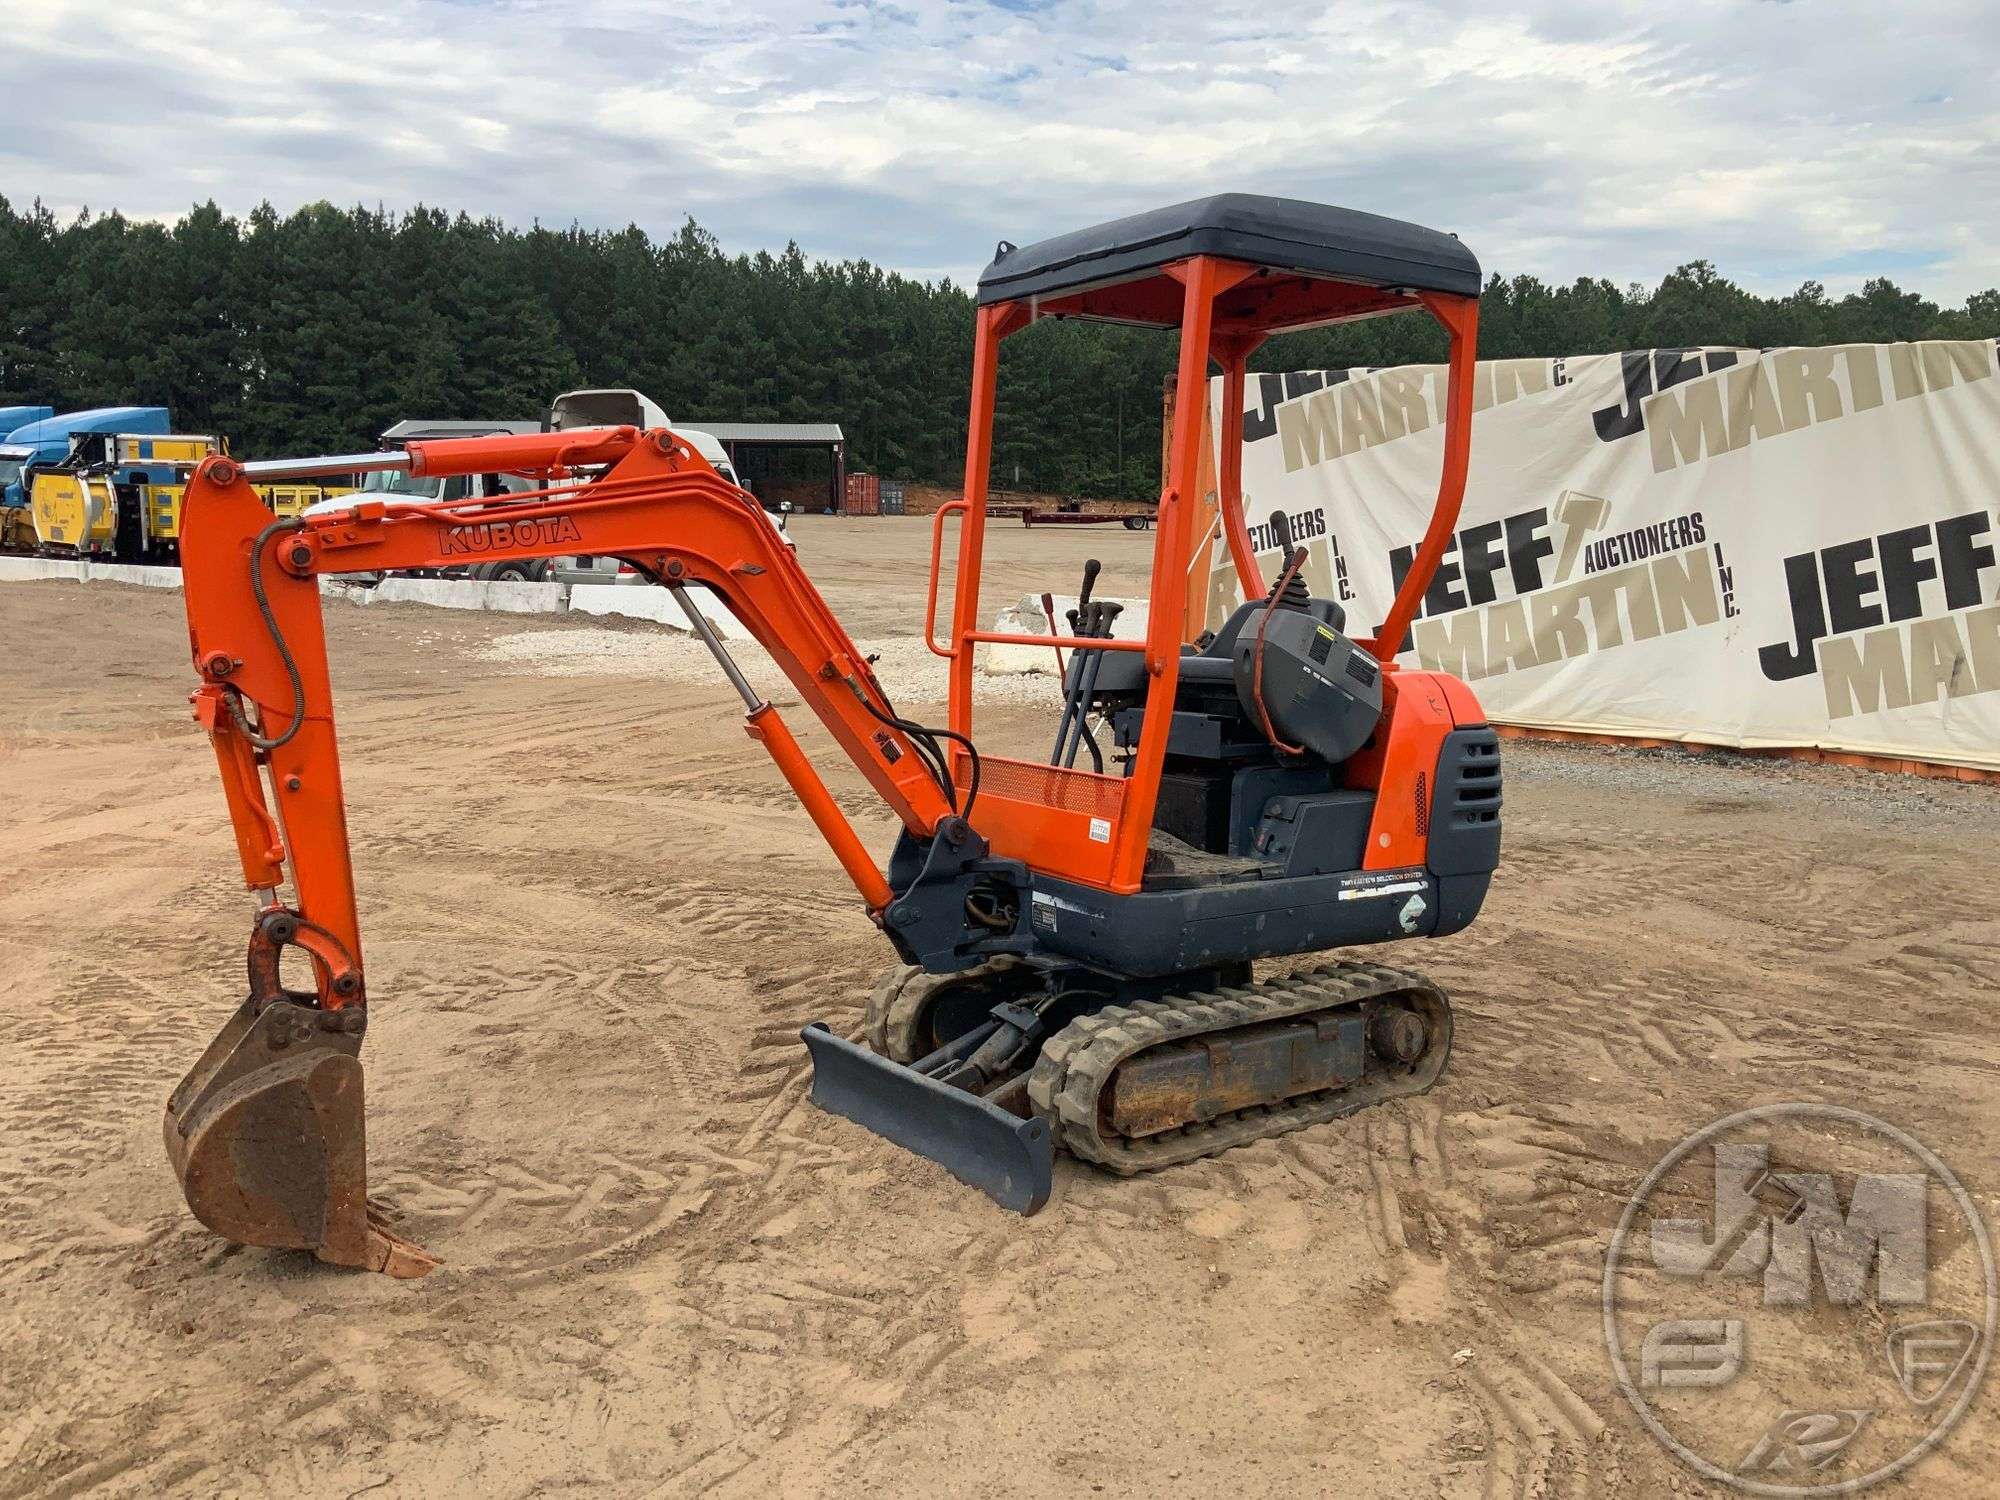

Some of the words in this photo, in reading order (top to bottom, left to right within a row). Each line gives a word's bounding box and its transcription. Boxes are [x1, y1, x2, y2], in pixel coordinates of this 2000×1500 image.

[1644, 342, 1991, 474] MARTIN
[437, 515, 581, 555] KUBOTA
[1331, 535, 1357, 601] INC.
[1584, 511, 1706, 575] AUCTIONEERS
[1415, 547, 1719, 681] MARTIN
[1714, 542, 1740, 618] INC.
[1758, 510, 1996, 682] JEFF
